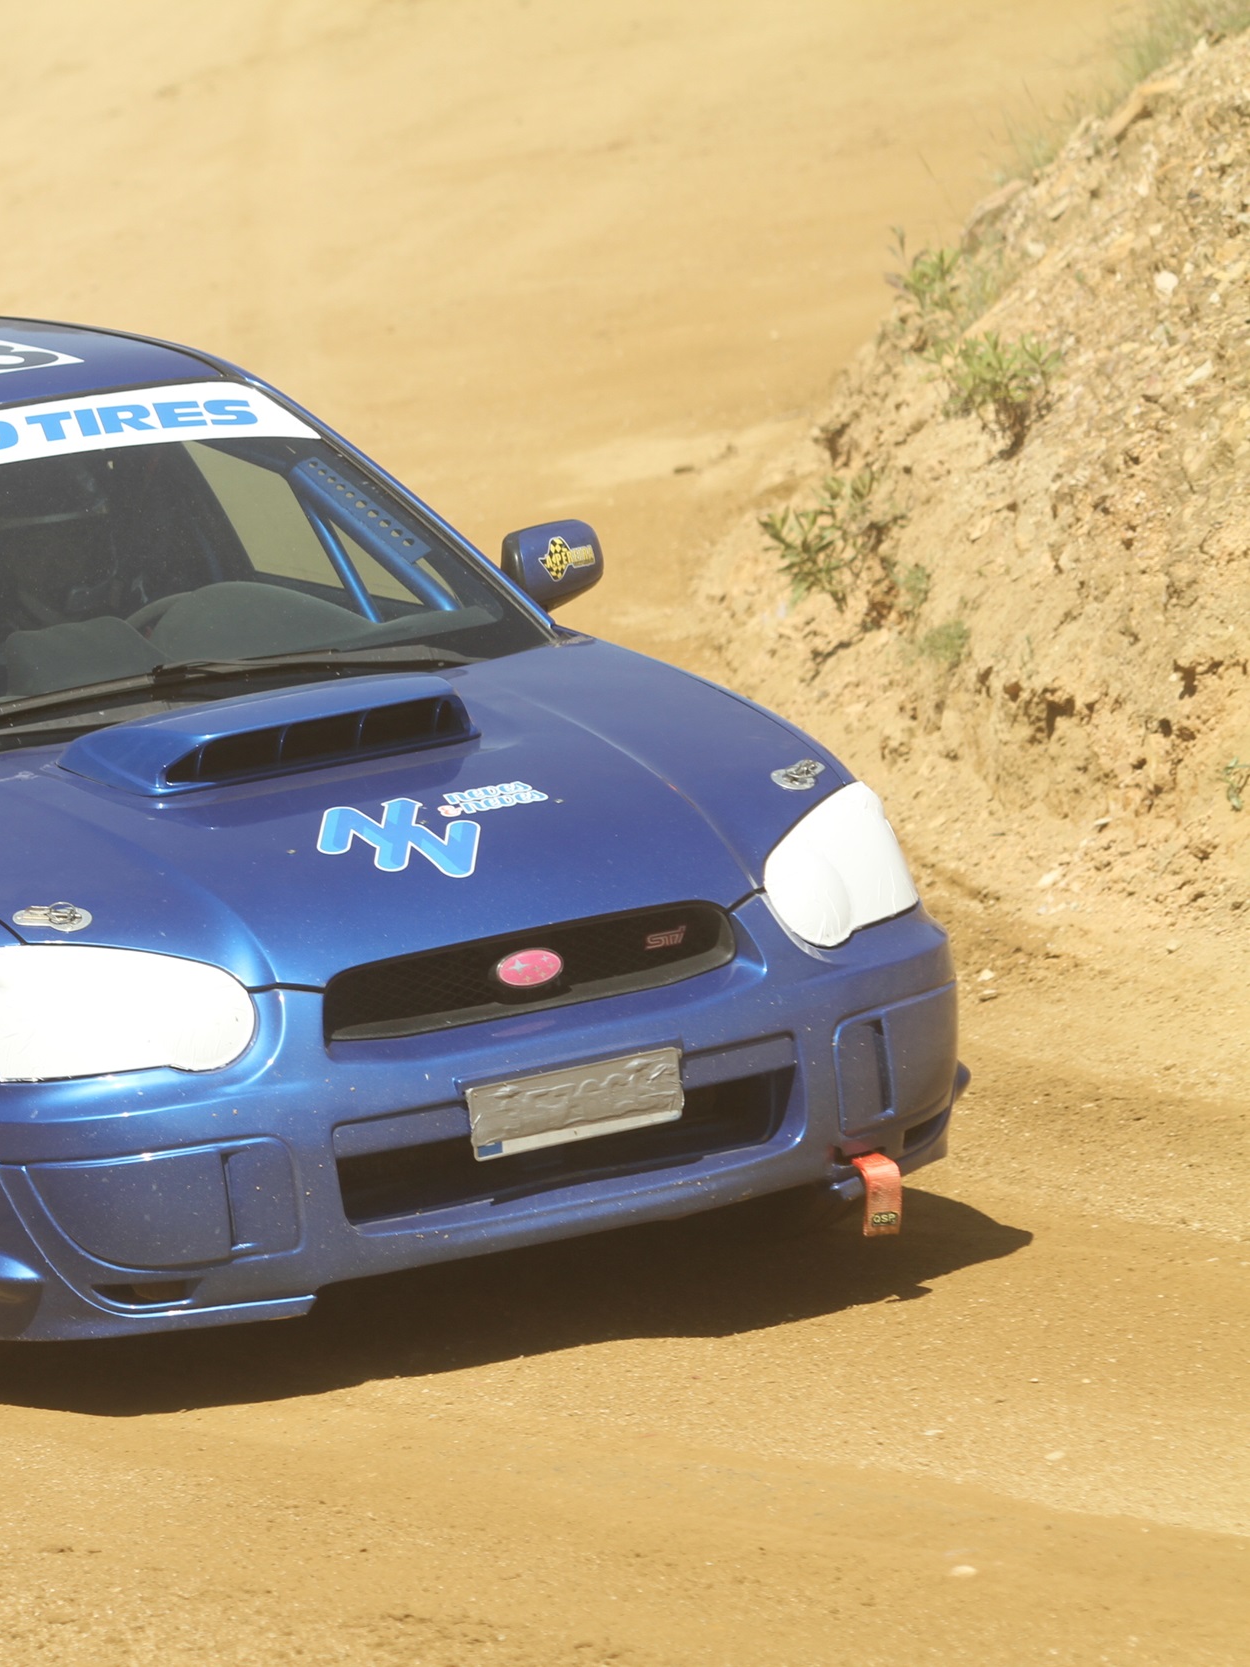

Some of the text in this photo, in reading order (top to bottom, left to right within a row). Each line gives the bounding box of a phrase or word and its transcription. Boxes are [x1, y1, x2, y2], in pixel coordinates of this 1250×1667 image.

[24, 399, 258, 442] TIRES
[443, 781, 533, 805] neves
[459, 790, 549, 814] neves
[873, 1213, 896, 1224] QSP
